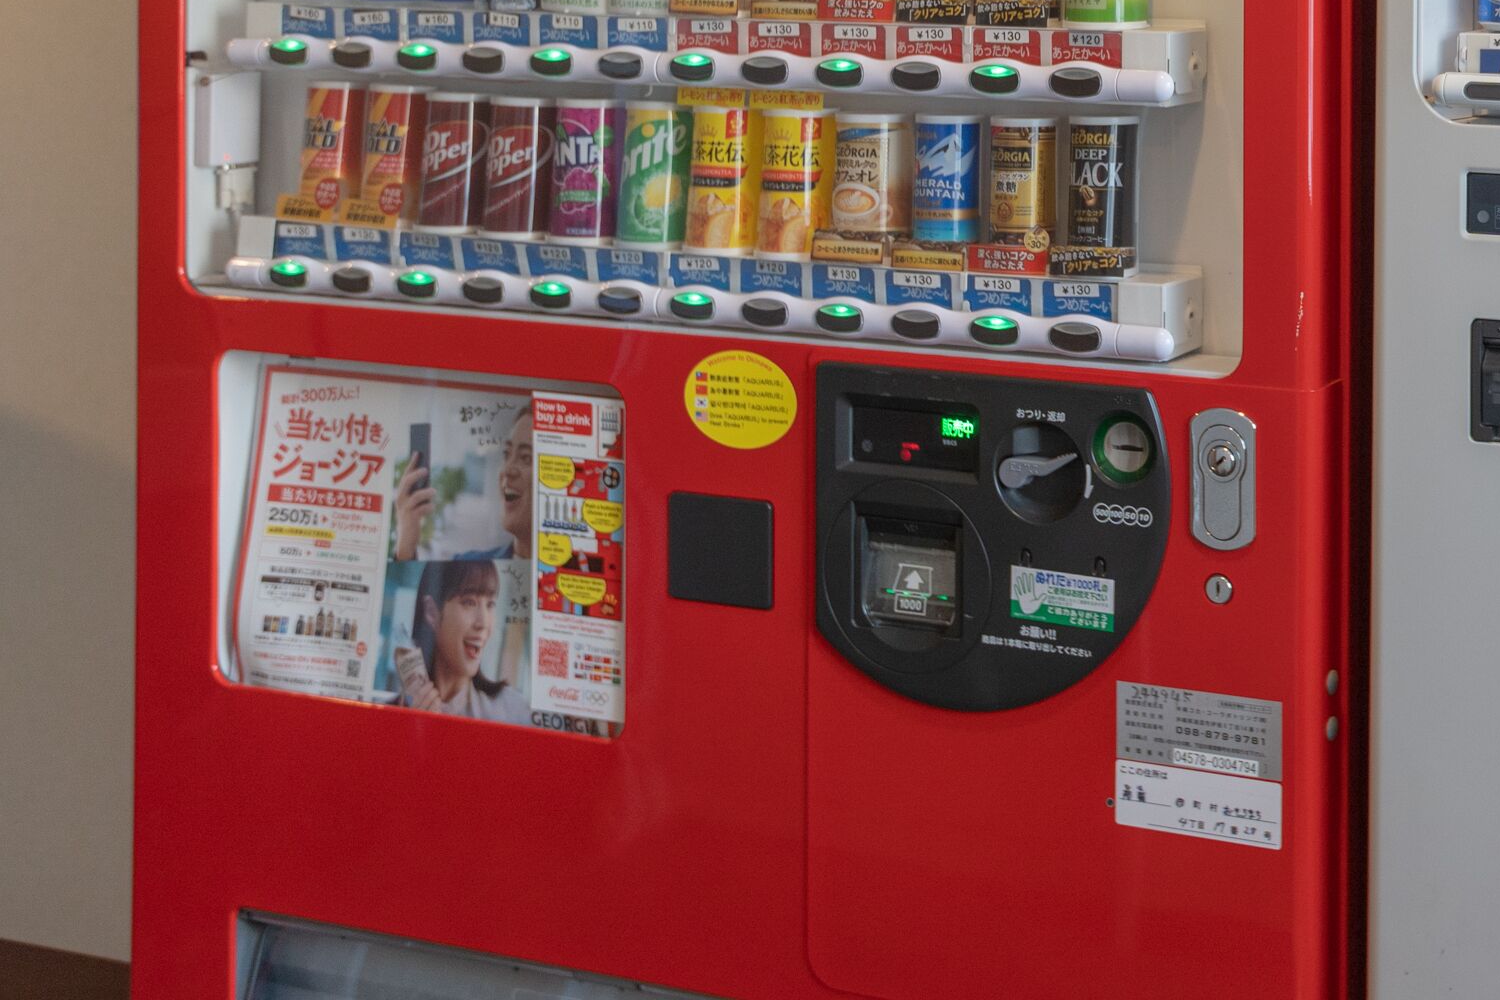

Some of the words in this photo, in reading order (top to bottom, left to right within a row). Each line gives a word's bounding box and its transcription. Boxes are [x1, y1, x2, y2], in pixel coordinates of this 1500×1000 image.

[425, 14, 449, 24] ¥160
[492, 14, 517, 25] ¥110
[555, 16, 580, 26] ¥110
[629, 19, 653, 29] ¥110
[698, 22, 725, 31] ¥130
[766, 25, 792, 34] ¥130
[841, 27, 869, 37] ¥130
[916, 29, 944, 39] ¥130
[993, 31, 1021, 41] ¥130
[1072, 35, 1100, 45] ¥120
[1075, 149, 1107, 160] DEEP
[686, 259, 713, 268] ¥120
[759, 263, 784, 273] ¥120
[831, 270, 857, 280] ¥130
[904, 275, 932, 286] ¥130
[983, 279, 1012, 289] ¥130
[1062, 285, 1091, 295] ¥130
[535, 401, 555, 411] How
[556, 402, 567, 412] to
[536, 410, 554, 424] buy
[556, 414, 563, 423] a
[564, 413, 591, 427] drink
[286, 407, 384, 446] 当たり付き
[941, 417, 974, 439] 販売中
[272, 443, 385, 486] ジョージア
[899, 599, 922, 612] 1000
[1174, 750, 1257, 775] 04578-0304794
